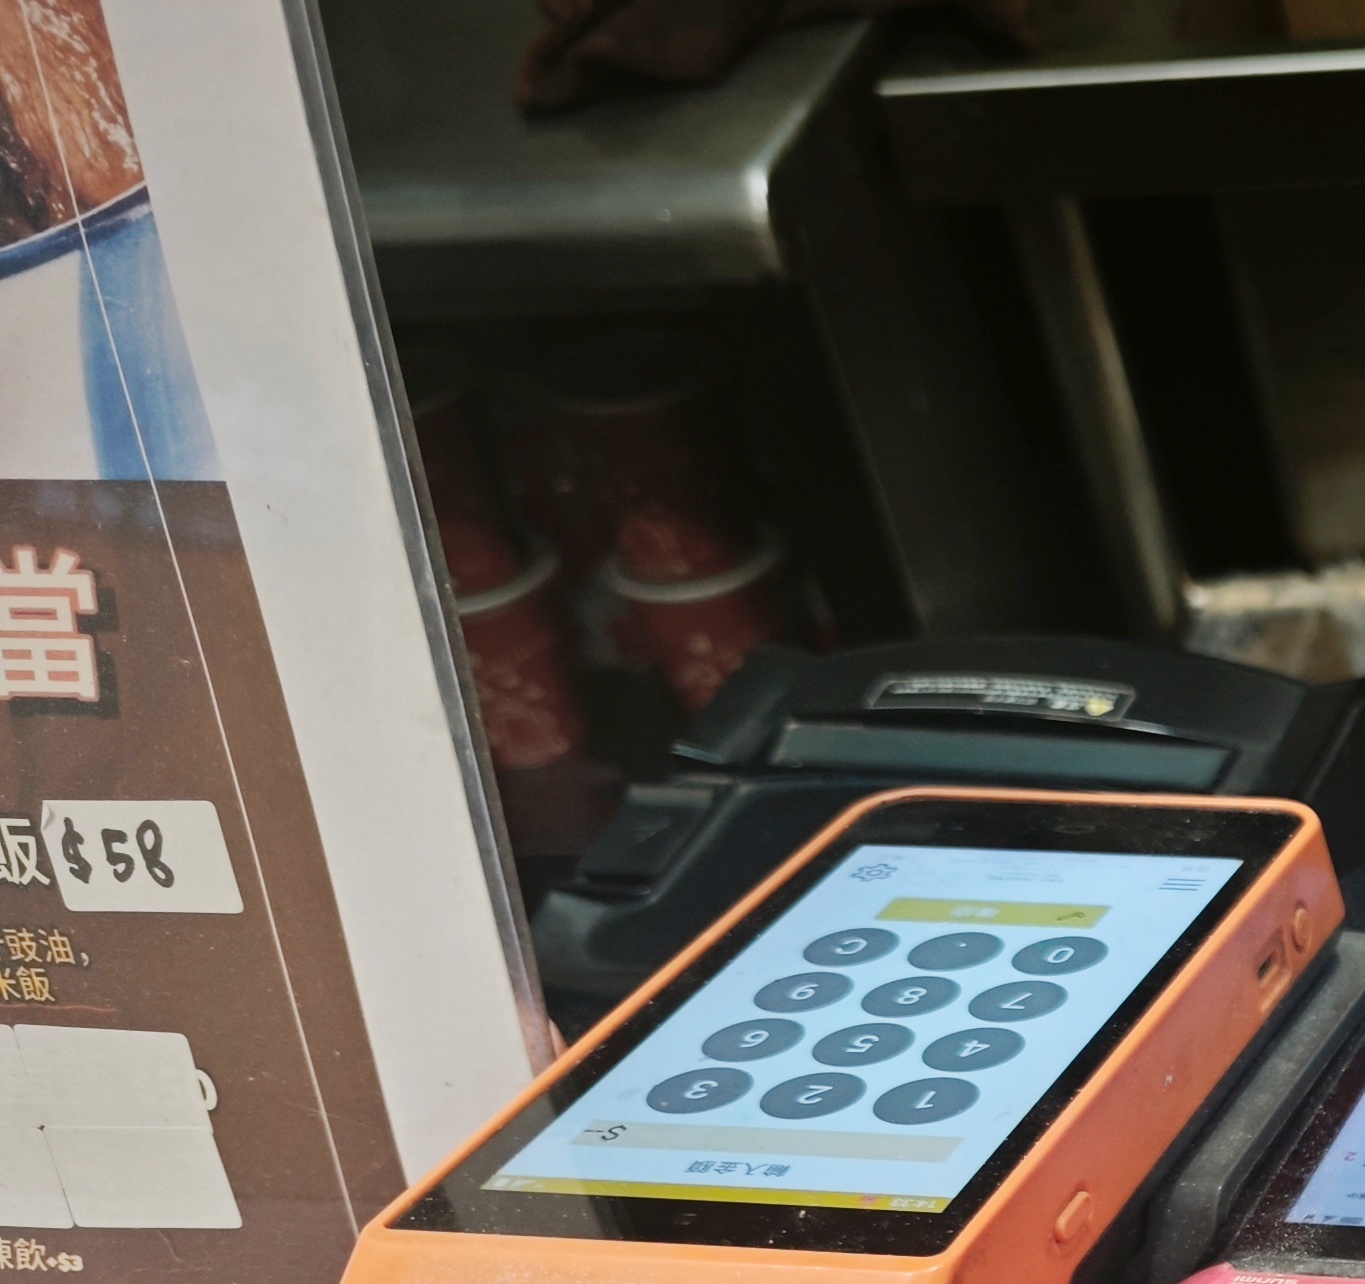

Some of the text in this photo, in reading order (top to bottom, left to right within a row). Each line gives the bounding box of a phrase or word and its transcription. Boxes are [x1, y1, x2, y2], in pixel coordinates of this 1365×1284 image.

[60, 818, 176, 890] $58
[1047, 945, 1073, 964] 0
[790, 982, 1029, 1009] 7 8 9
[742, 1028, 989, 1058] 4 5 6
[687, 1079, 939, 1112] 1 2 3
[687, 1158, 792, 1179] 輸入金額
